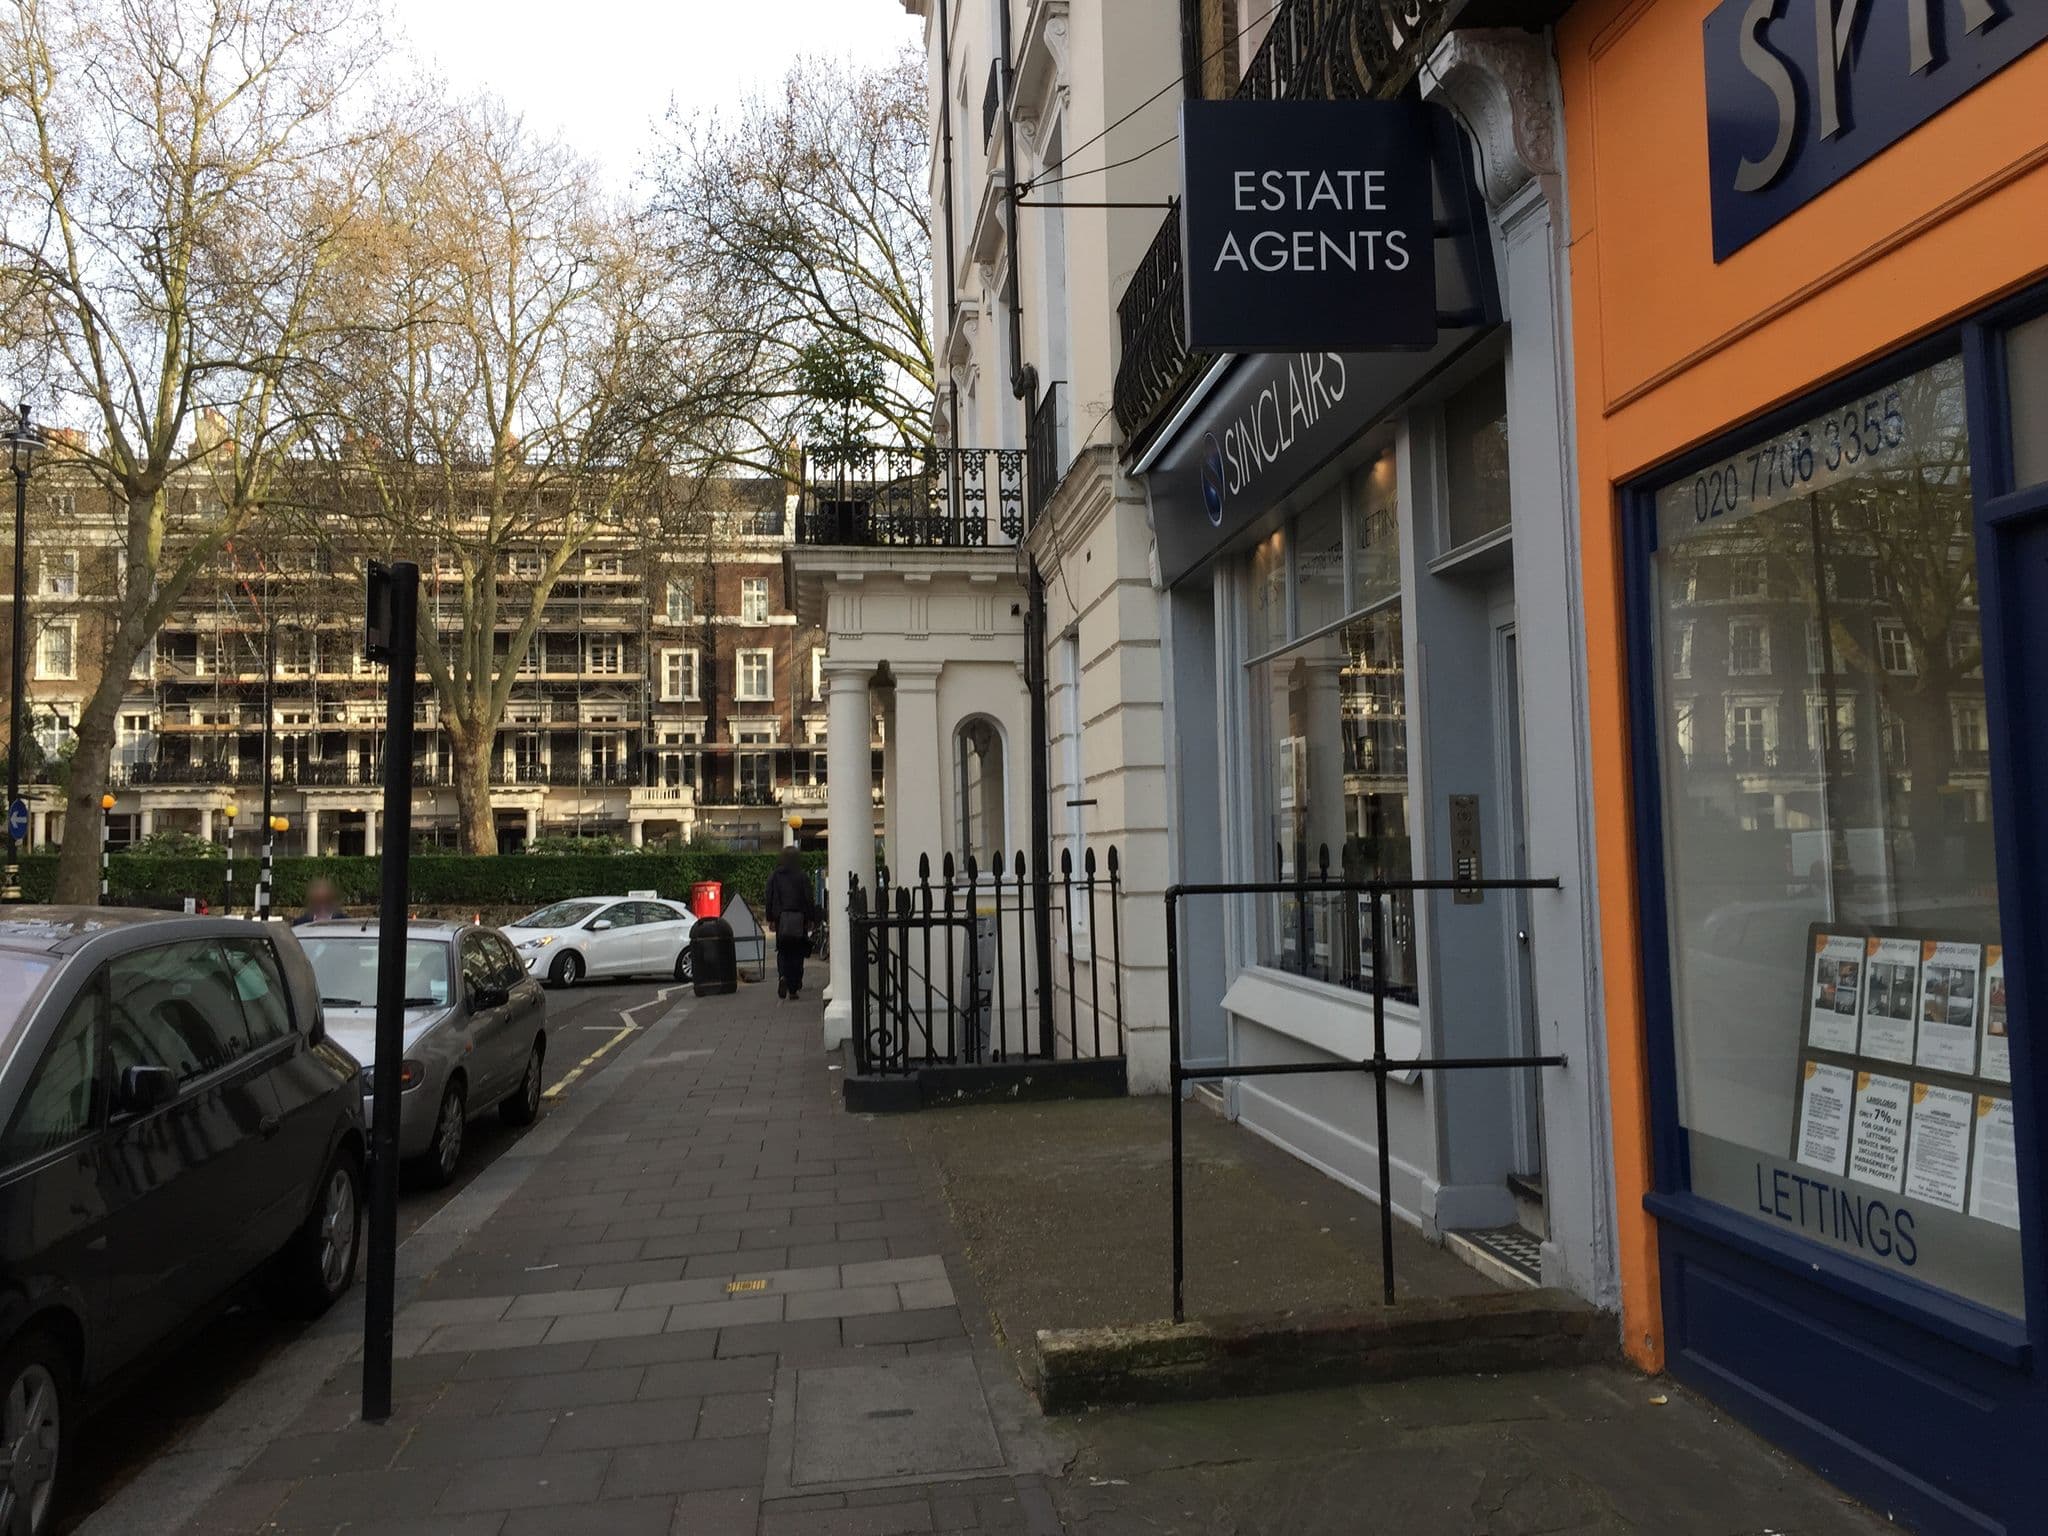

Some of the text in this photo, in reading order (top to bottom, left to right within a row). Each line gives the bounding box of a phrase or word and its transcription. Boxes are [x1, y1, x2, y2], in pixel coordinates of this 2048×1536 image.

[1234, 169, 1387, 211] ESTATE
[1213, 230, 1410, 272] AGENTS
[1225, 352, 1346, 495] SINCLAIRS
[1695, 392, 1904, 522] 020 7706 3355
[1874, 1108, 1891, 1123] 7%
[1855, 1154, 1890, 1171] MANAGEMENT
[1757, 1163, 1918, 1266] LETTINGS
